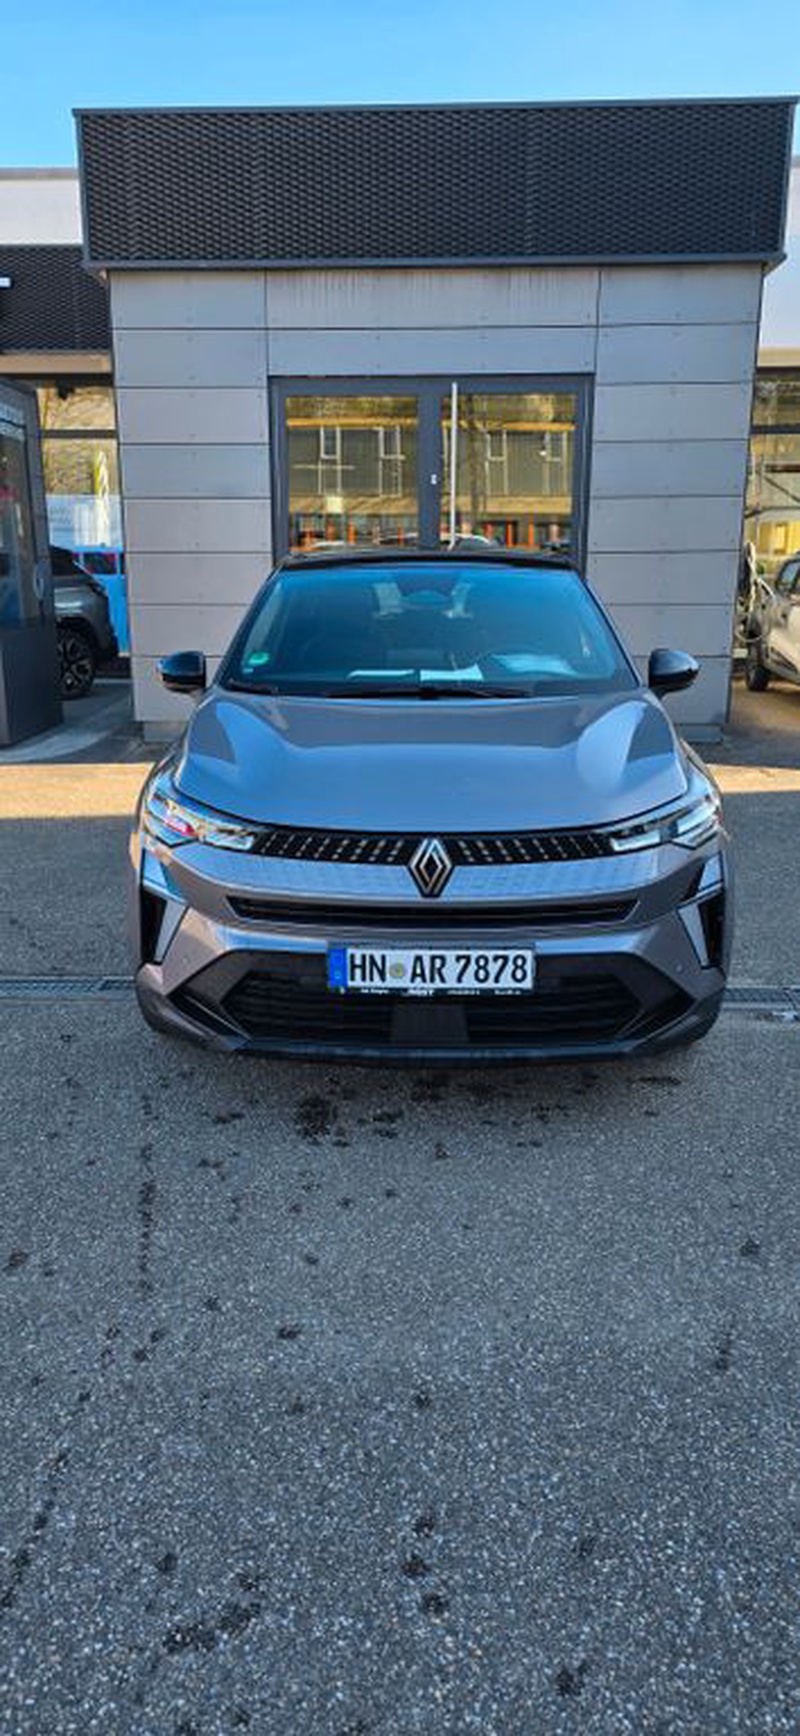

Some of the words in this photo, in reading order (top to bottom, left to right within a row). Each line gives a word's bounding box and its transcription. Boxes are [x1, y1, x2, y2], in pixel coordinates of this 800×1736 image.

[350, 954, 386, 983] HN
[410, 954, 447, 983] AR
[455, 954, 527, 983] 7878
